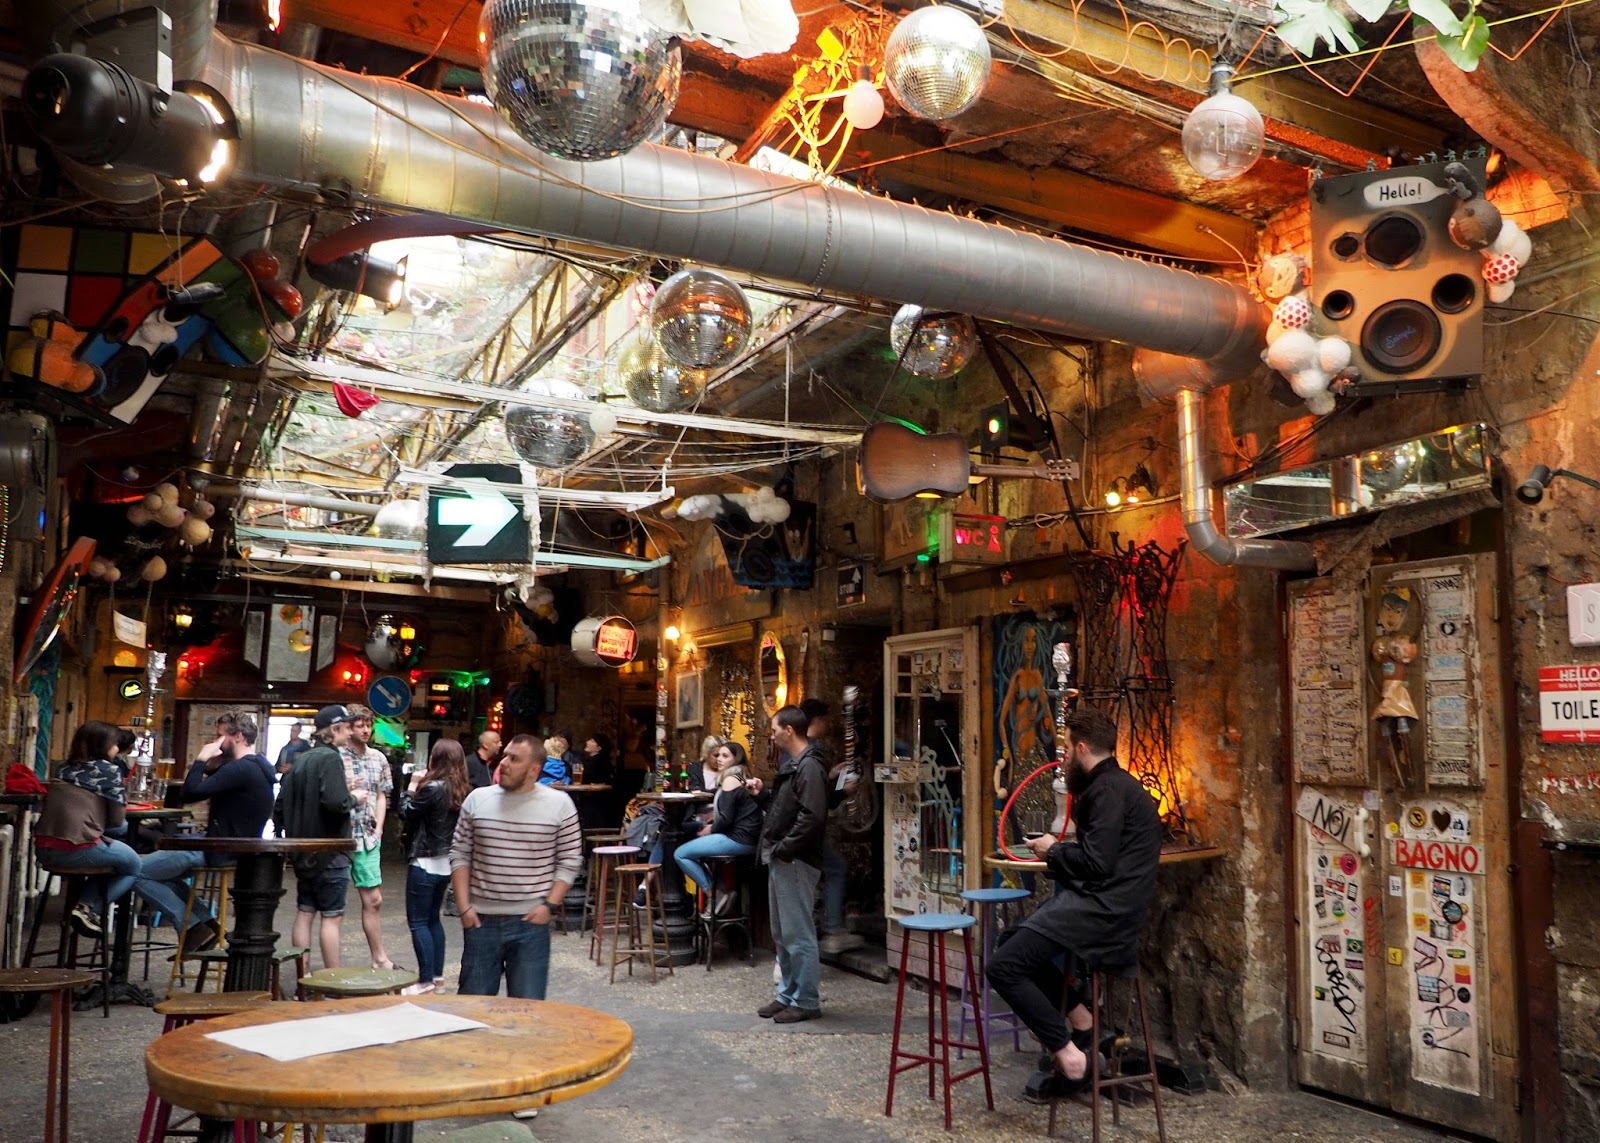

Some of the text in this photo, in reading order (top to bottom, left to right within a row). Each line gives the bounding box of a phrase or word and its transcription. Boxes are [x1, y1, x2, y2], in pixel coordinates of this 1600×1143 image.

[1380, 182, 1422, 201] Hello!
[955, 528, 985, 546] WC
[1551, 699, 1600, 720] TOILE
[1396, 839, 1479, 873] BAGNO
